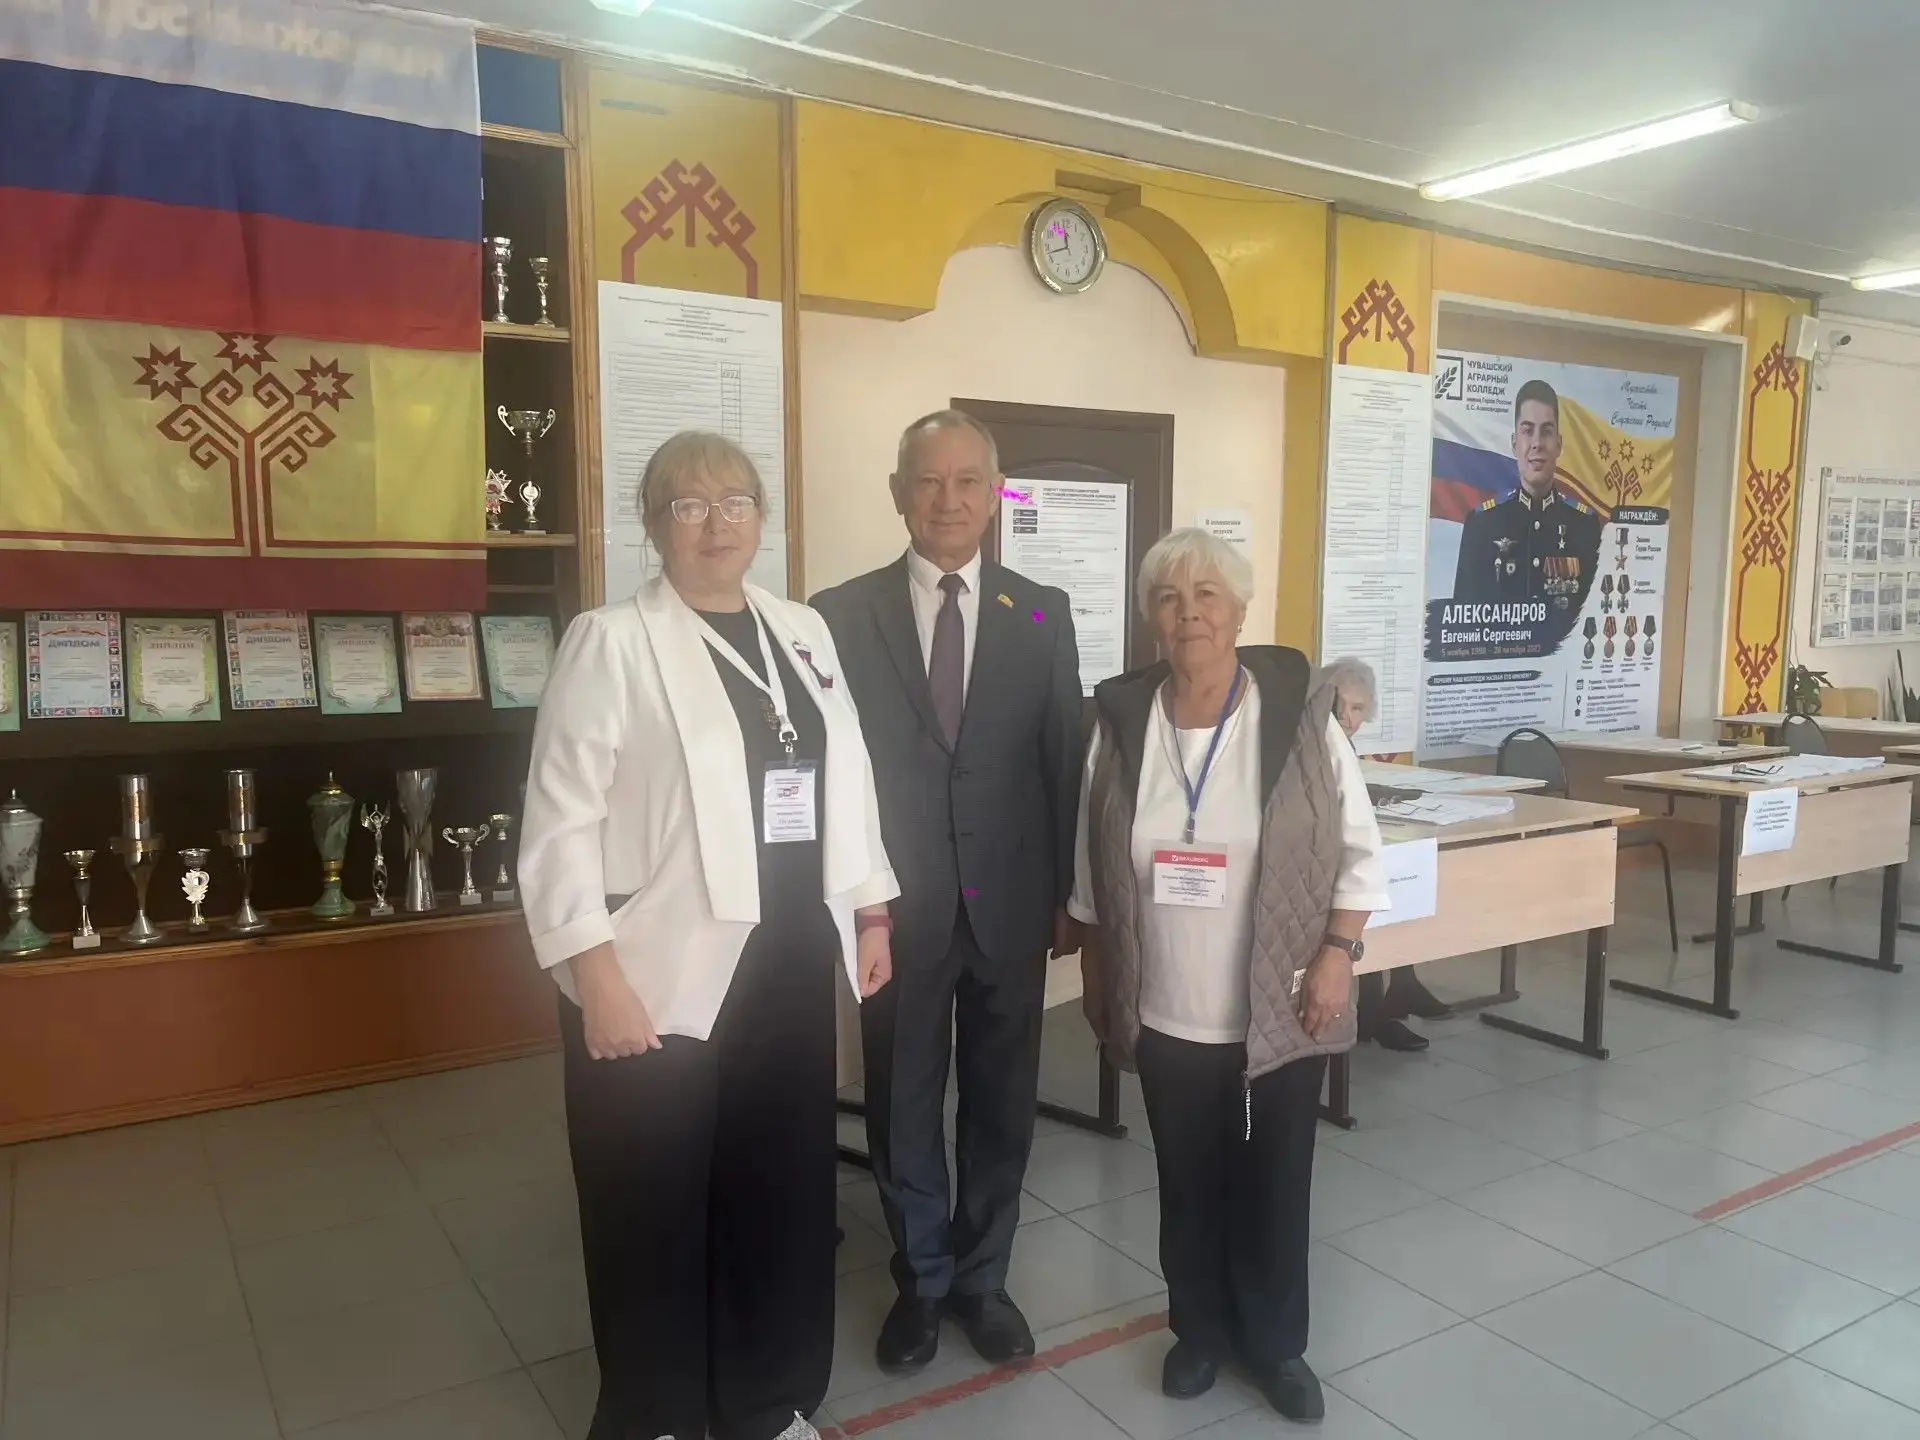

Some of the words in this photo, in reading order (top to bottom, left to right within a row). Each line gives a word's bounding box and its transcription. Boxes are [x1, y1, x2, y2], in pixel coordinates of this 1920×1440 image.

[1466, 360, 1513, 373] ЧУВАШСКИЙ
[1466, 372, 1509, 384] АГРАРНЫЙ
[1466, 384, 1506, 396] КОЛЛЕДЖ
[1441, 602, 1547, 625] АЛЕКСАНДРОВ
[1441, 628, 1481, 644] Евгений
[1482, 628, 1532, 644] Сергеевич
[48, 639, 100, 648] ДИПЛОМ
